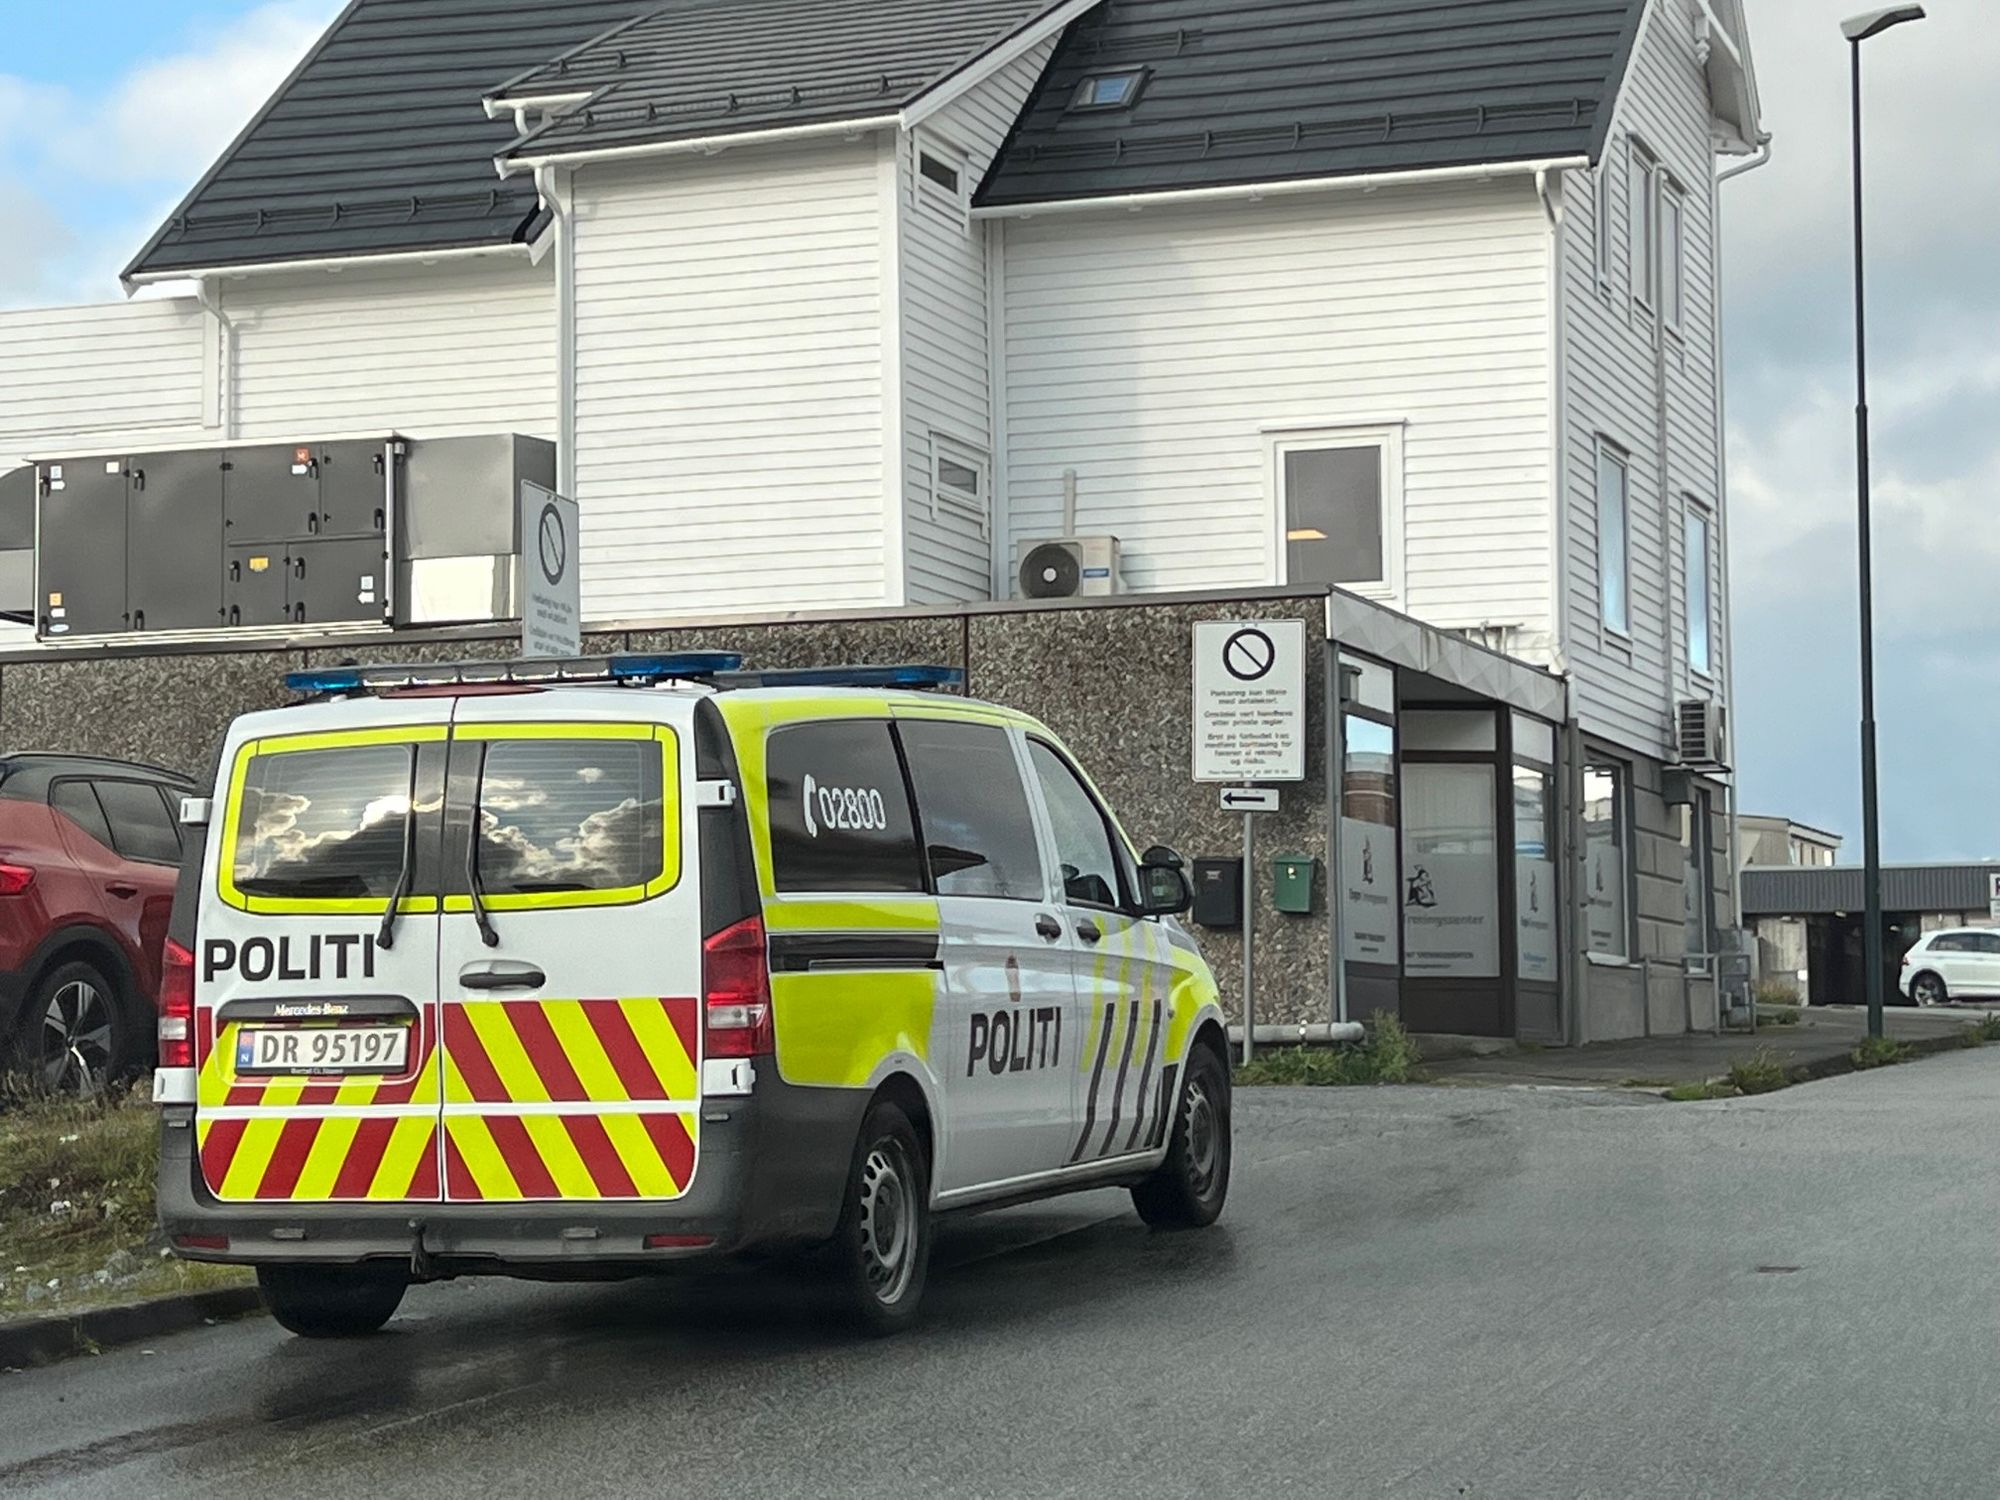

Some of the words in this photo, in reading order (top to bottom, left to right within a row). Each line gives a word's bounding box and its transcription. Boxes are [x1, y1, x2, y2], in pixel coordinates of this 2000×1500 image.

[818, 786, 887, 830] 02800
[203, 933, 375, 983] POLITI
[273, 1002, 350, 1016] Mercedes-Benz
[261, 1034, 299, 1064] DR
[312, 1033, 399, 1063] 95197
[967, 1006, 1062, 1077] POLITI
